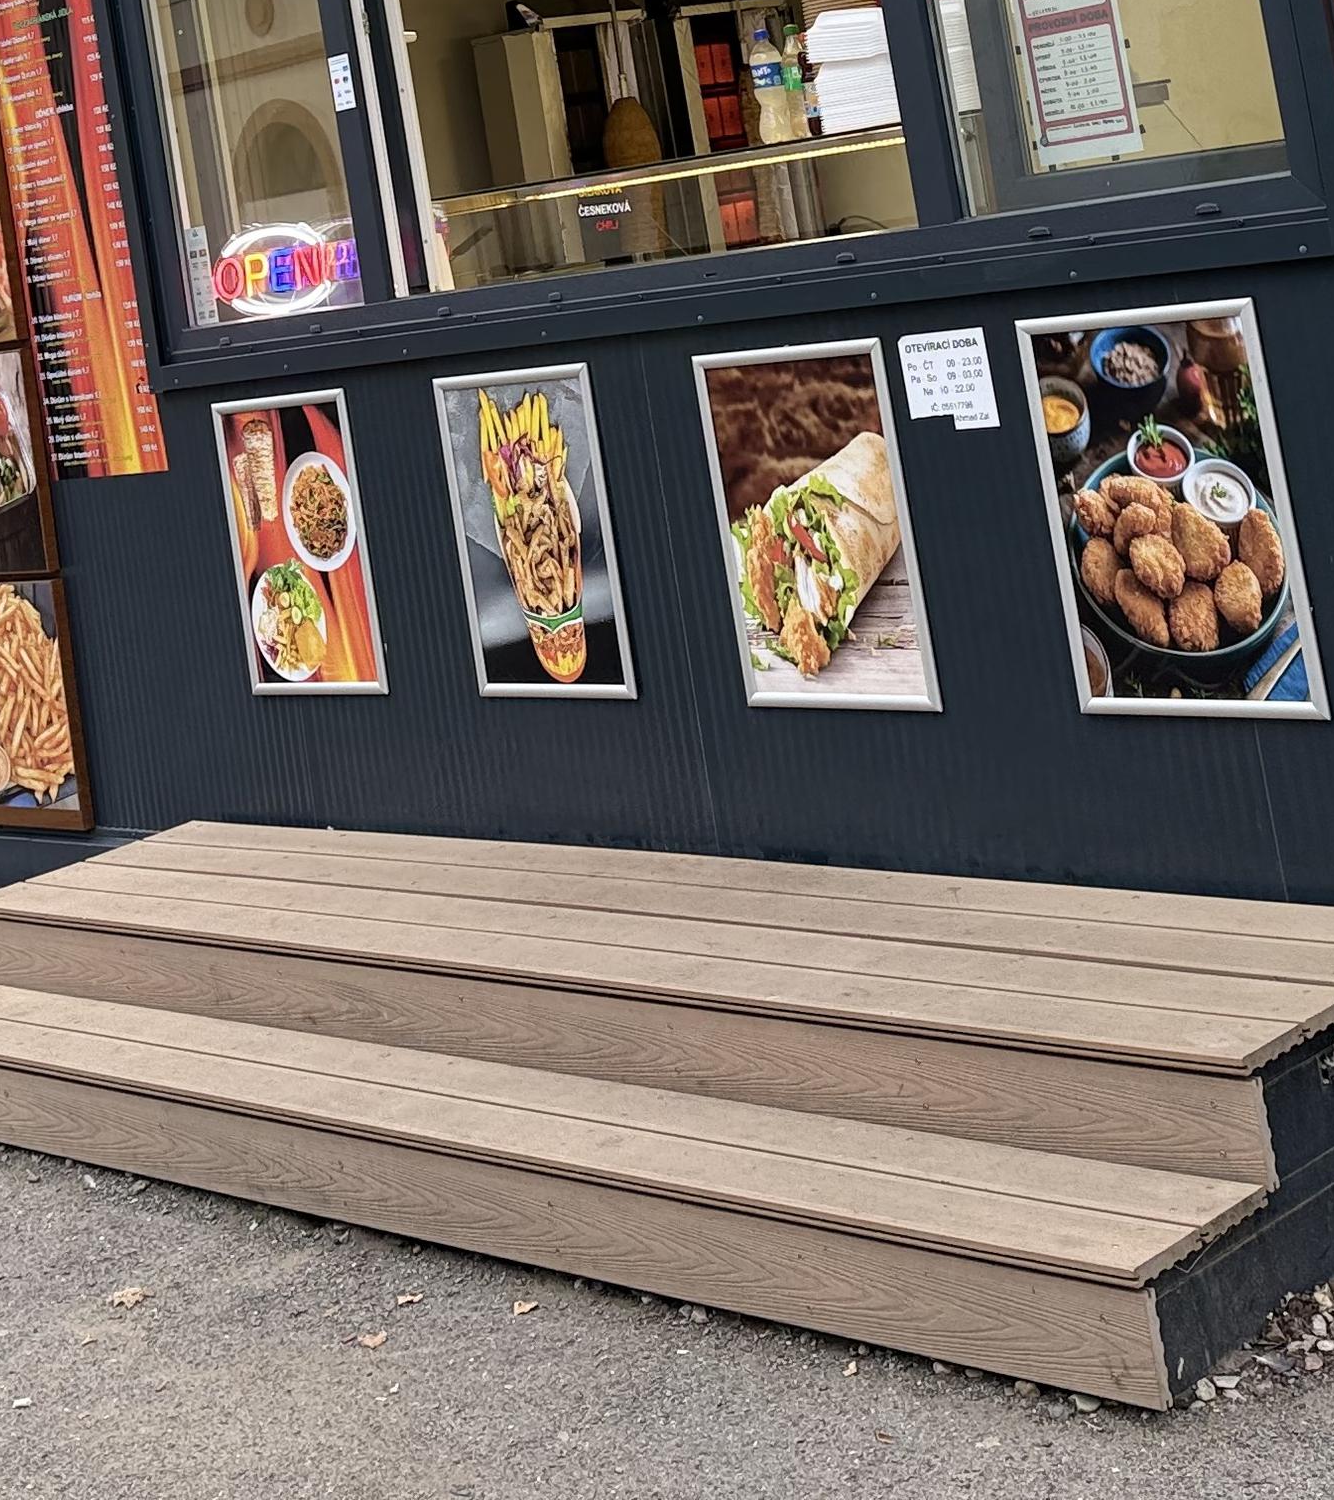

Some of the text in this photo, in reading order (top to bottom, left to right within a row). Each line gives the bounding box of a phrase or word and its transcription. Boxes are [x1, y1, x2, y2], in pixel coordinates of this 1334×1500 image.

[578, 199, 631, 217] ČESNEKOVÁ
[214, 242, 323, 301] OPEN
[905, 338, 979, 354] OTEVÍRACÍ DOBA
